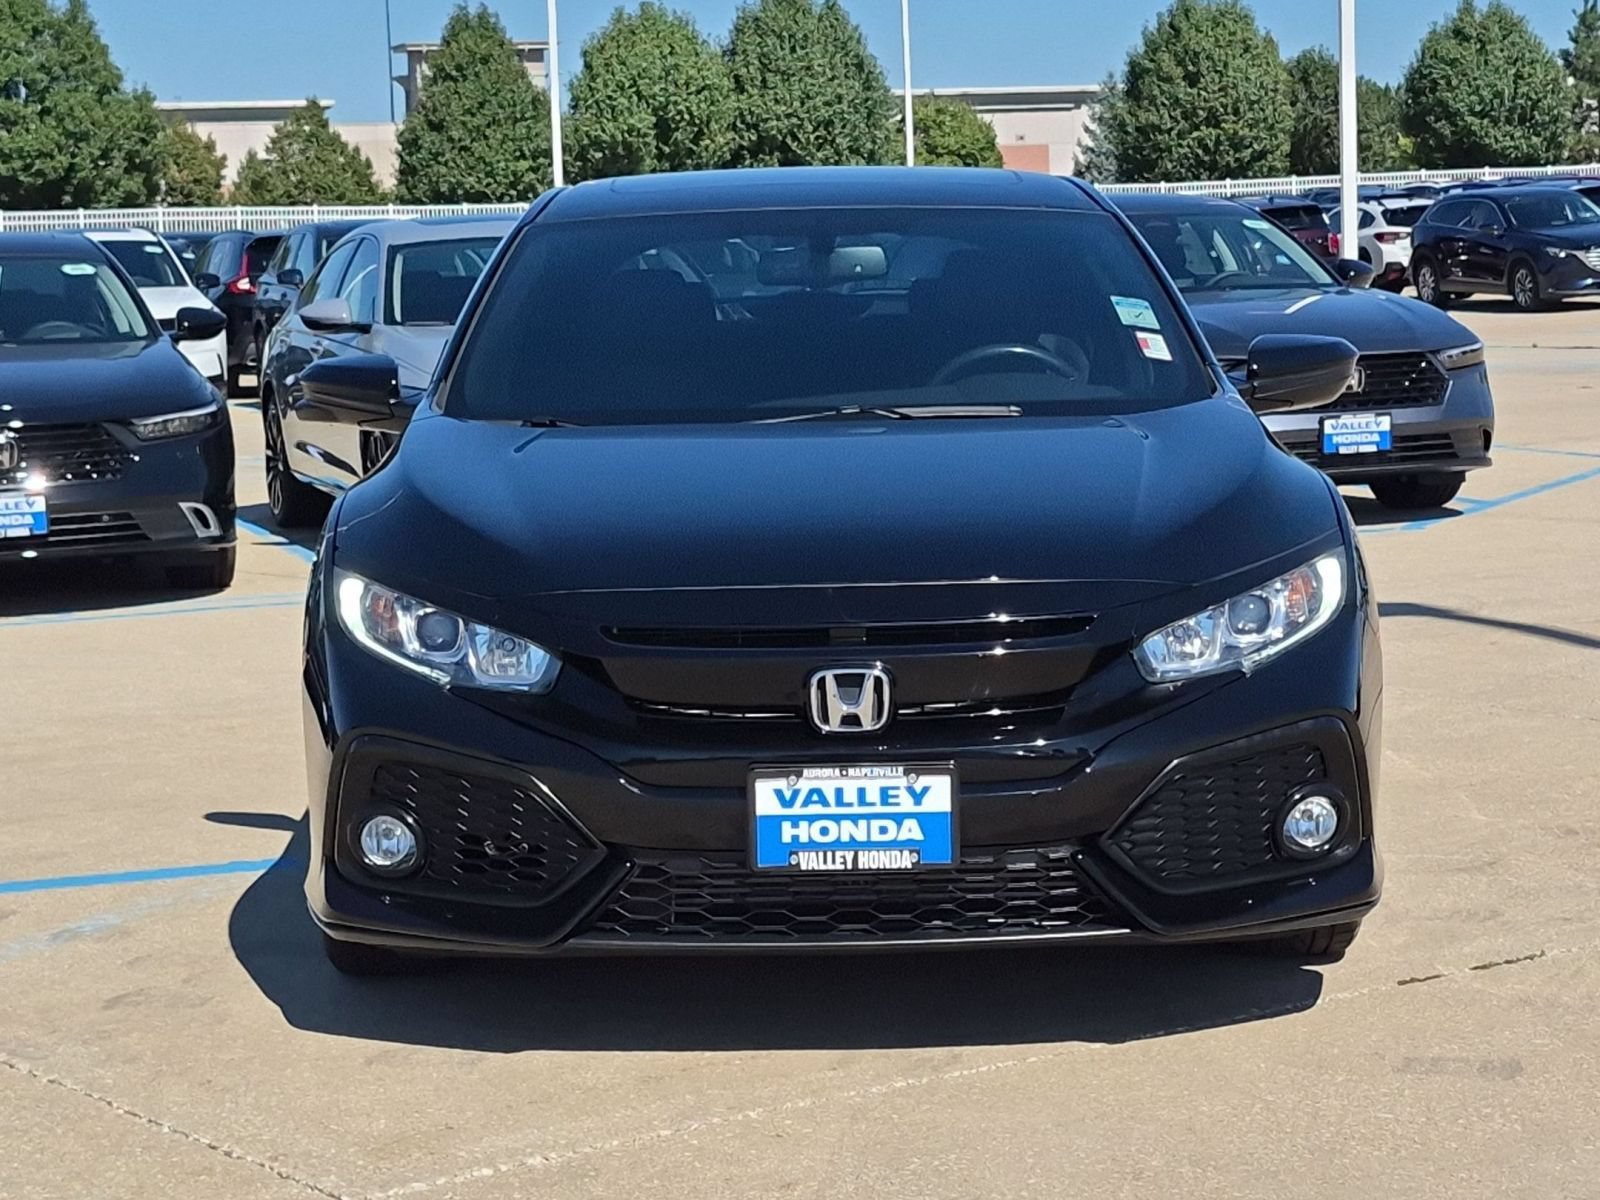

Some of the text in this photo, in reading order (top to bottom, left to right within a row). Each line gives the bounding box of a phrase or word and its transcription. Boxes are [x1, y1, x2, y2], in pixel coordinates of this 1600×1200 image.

[1330, 420, 1382, 430] VALLEY
[1332, 433, 1380, 444] HONDA
[802, 767, 841, 778] AURORA
[772, 785, 932, 809] VALLEY
[781, 818, 925, 843] HONDA
[798, 850, 913, 870] VALLEY HONDA
